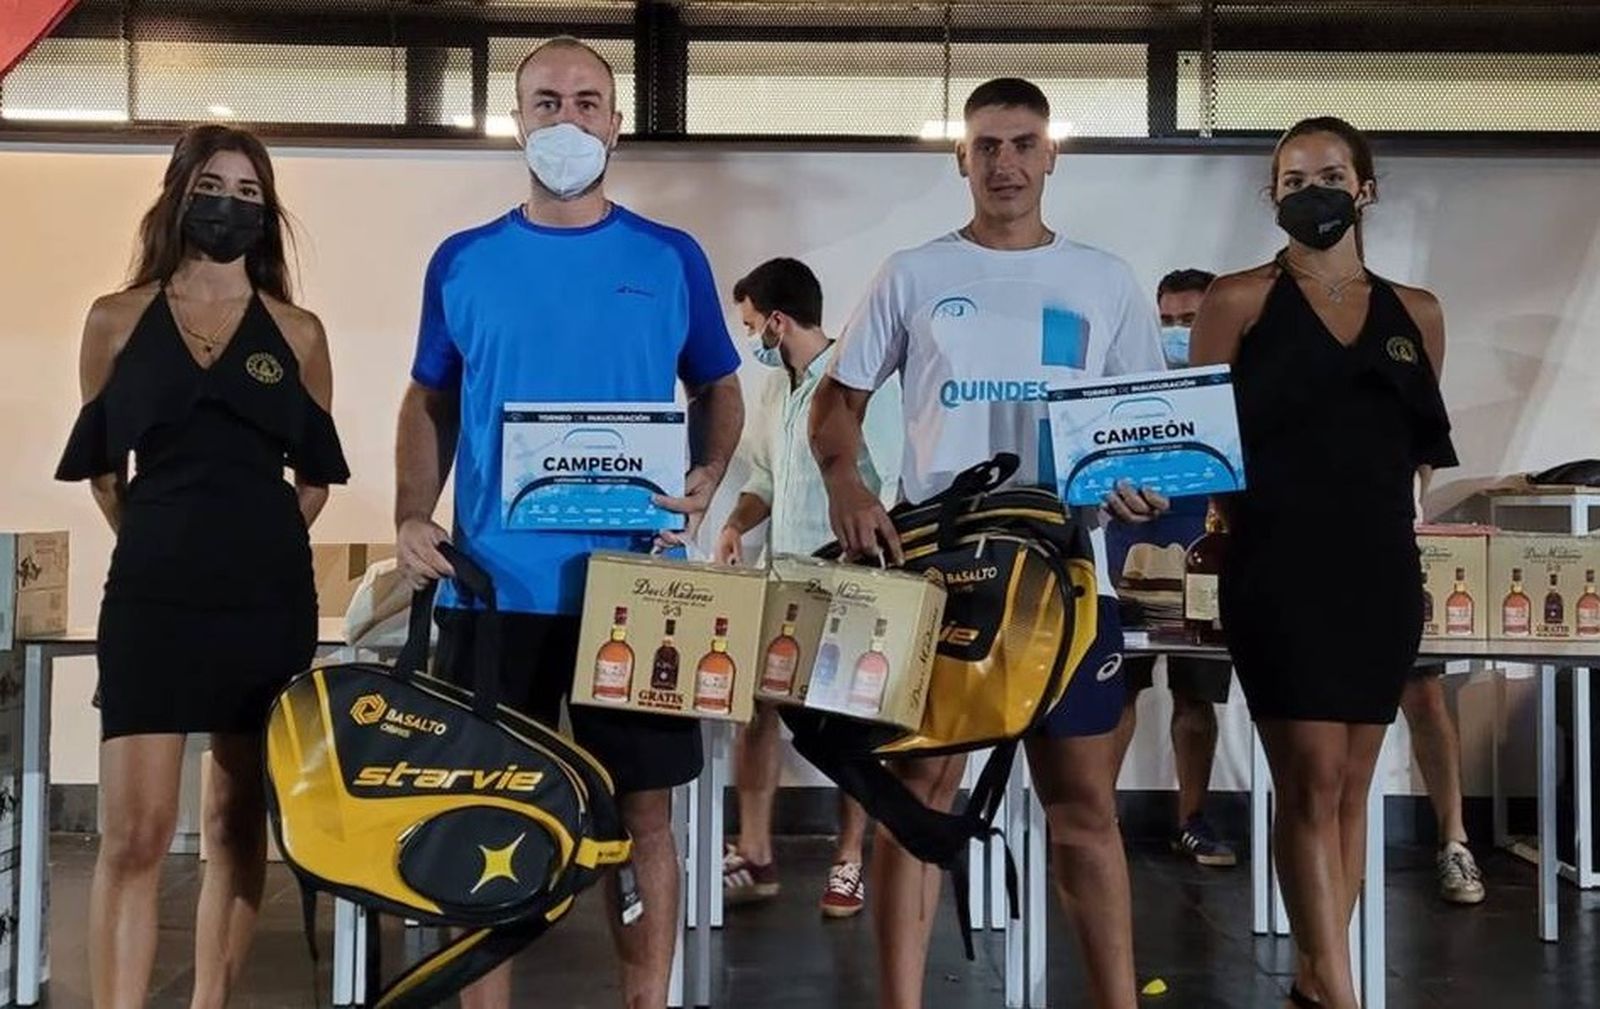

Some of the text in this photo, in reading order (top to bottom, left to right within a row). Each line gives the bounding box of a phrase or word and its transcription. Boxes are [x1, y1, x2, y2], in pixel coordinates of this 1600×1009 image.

[1082, 386, 1117, 398] TORNEO
[538, 413, 573, 422] TORNEO
[1093, 420, 1195, 445] CAMPEÓN
[543, 453, 643, 472] CAMPEÓN
[638, 689, 684, 704] GRATIS
[385, 707, 447, 736] BASALTO
[353, 761, 544, 792] starvie
